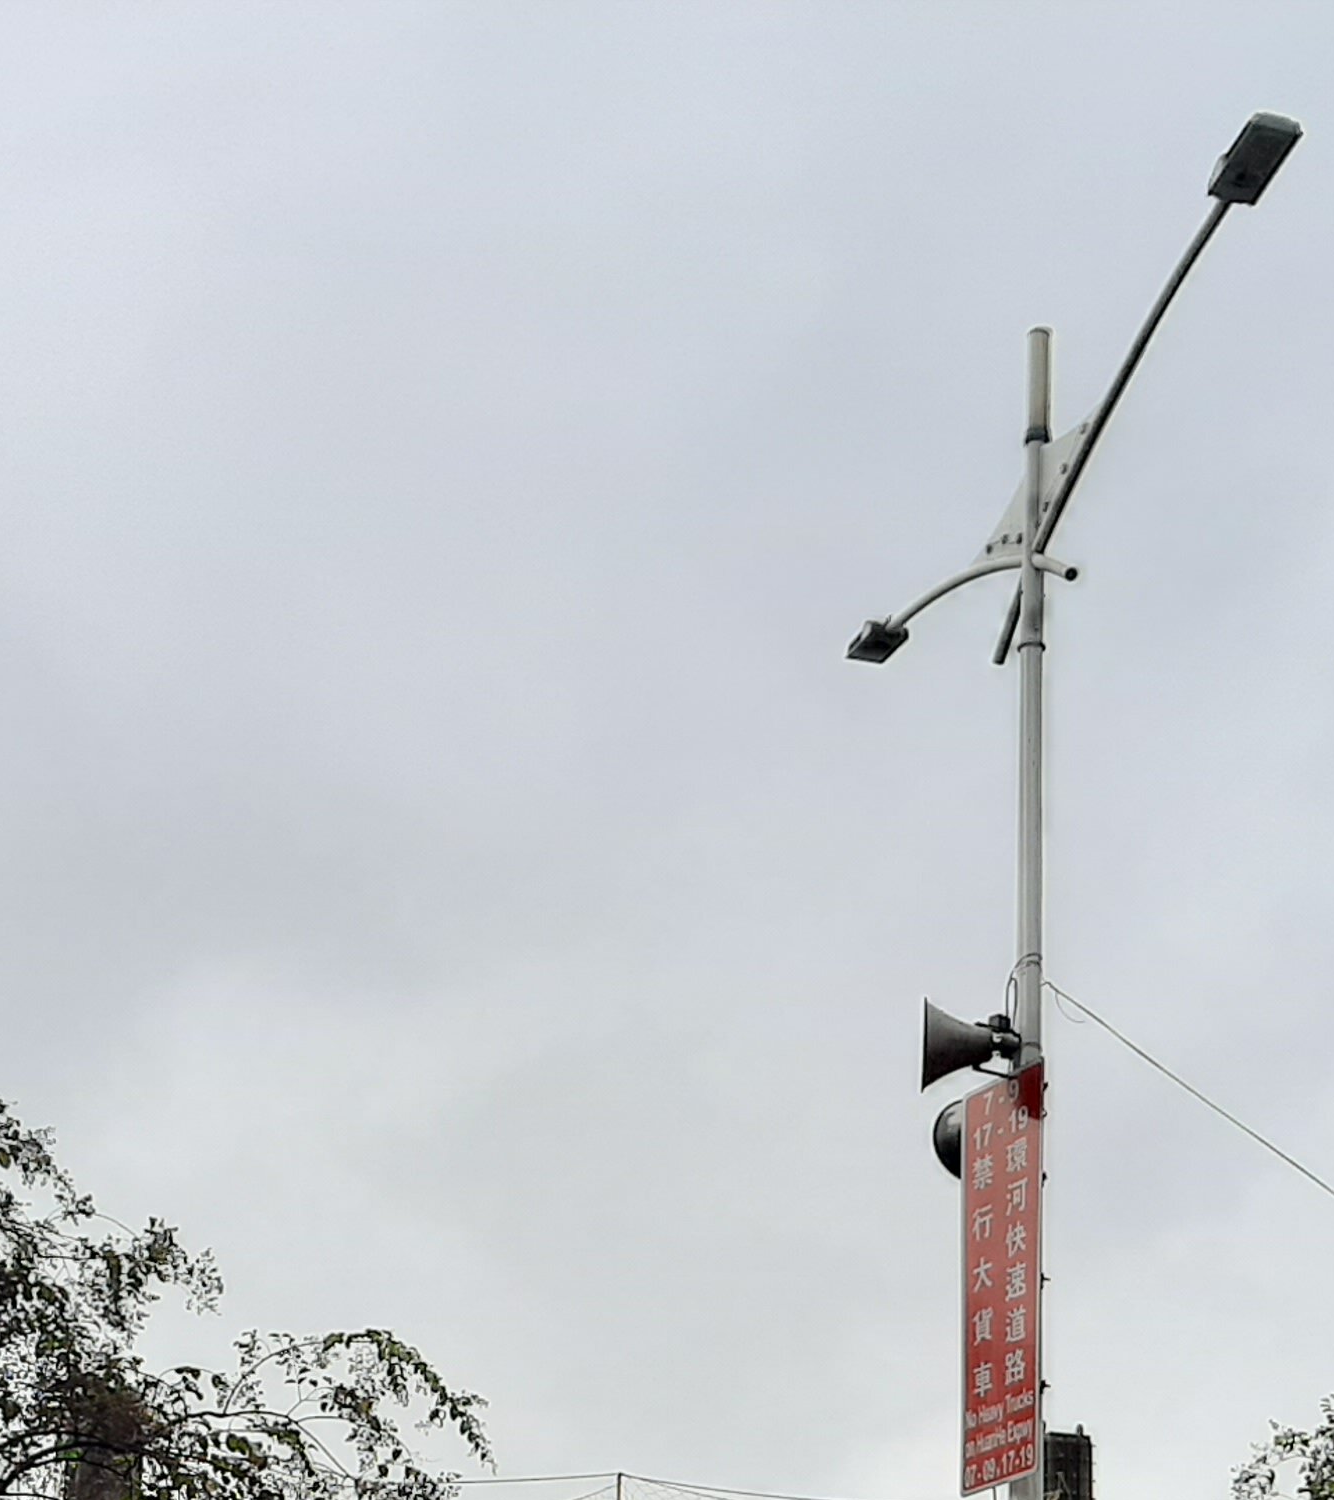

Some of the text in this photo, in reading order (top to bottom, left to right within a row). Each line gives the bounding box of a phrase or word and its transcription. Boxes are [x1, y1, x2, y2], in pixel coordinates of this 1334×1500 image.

[971, 1153, 995, 1398] 禁行大貨車
[1004, 1136, 1029, 1387] 環河快速道路
